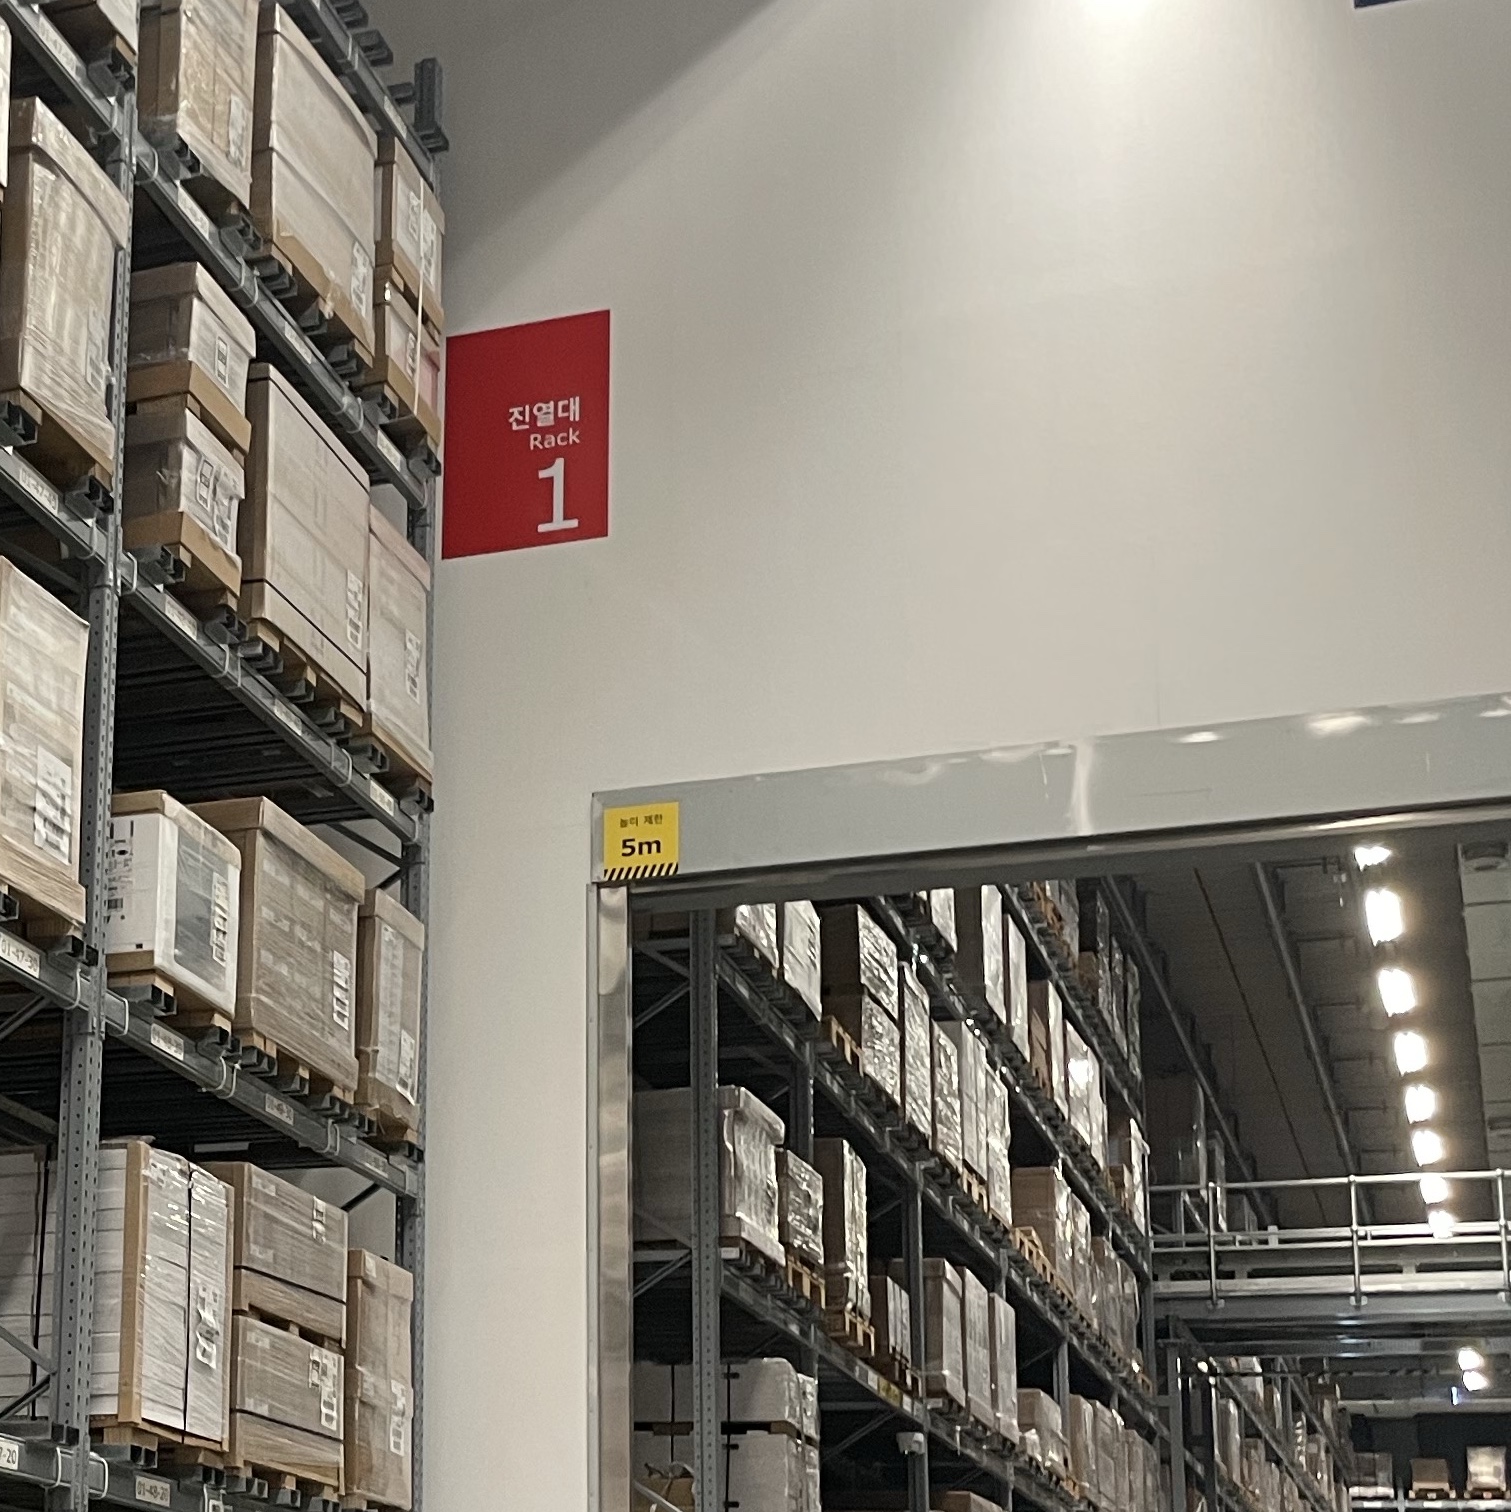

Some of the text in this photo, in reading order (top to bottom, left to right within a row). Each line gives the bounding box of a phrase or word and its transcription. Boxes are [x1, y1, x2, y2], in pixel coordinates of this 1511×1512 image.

[508, 396, 580, 431] 진열대
[530, 427, 580, 450] Rack
[537, 457, 579, 532] 1
[621, 838, 662, 857] 5m
